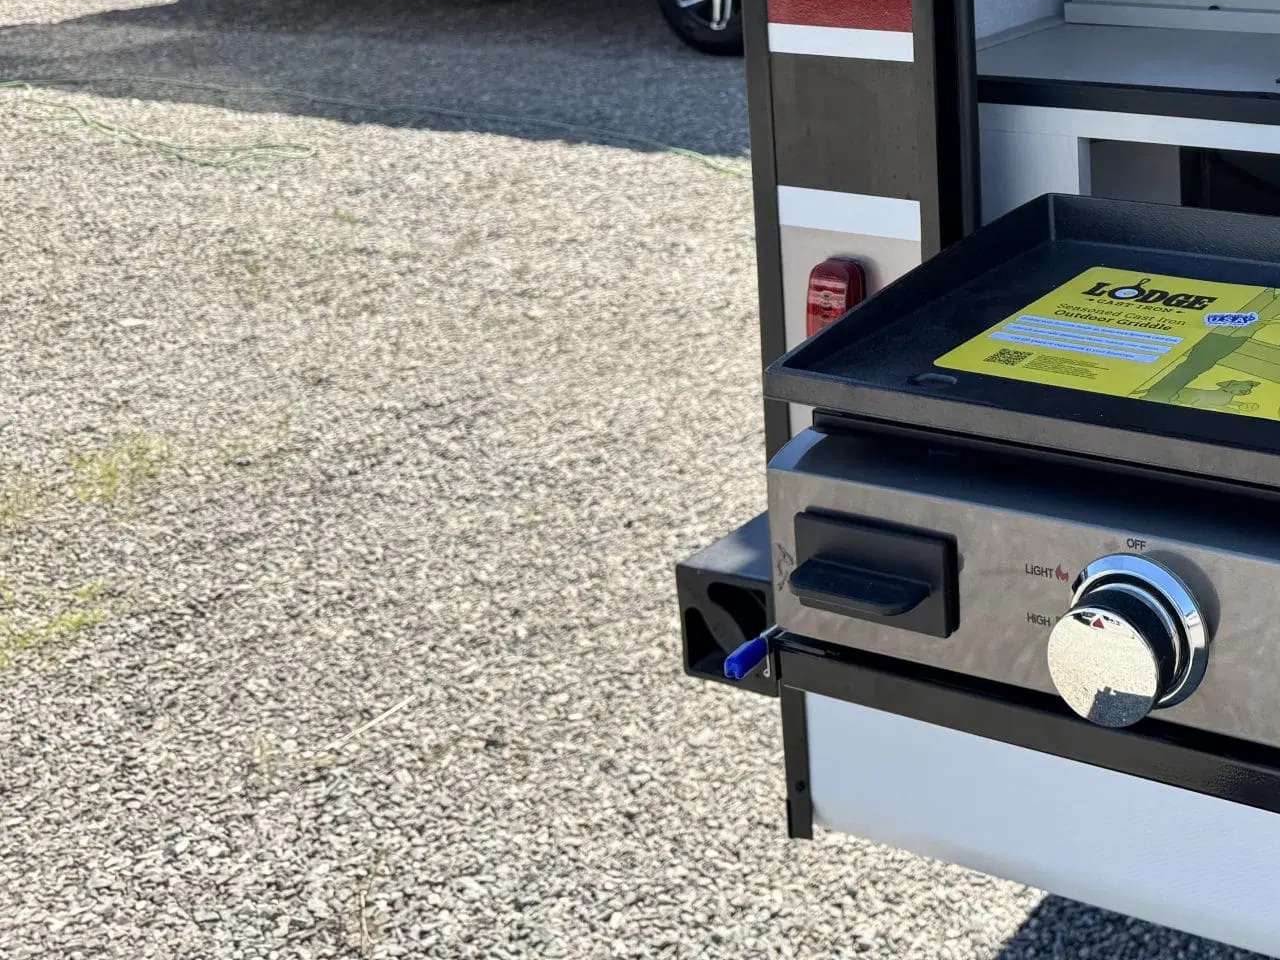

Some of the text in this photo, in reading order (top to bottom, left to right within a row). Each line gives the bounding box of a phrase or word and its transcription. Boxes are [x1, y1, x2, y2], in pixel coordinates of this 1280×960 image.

[1081, 280, 1218, 310] LODGE
[1054, 308, 1114, 323] Outdoor
[1116, 317, 1172, 331] Griddle
[1126, 538, 1146, 551] OFF
[1025, 563, 1054, 578] LIGHT
[1027, 612, 1051, 626] HIGH
